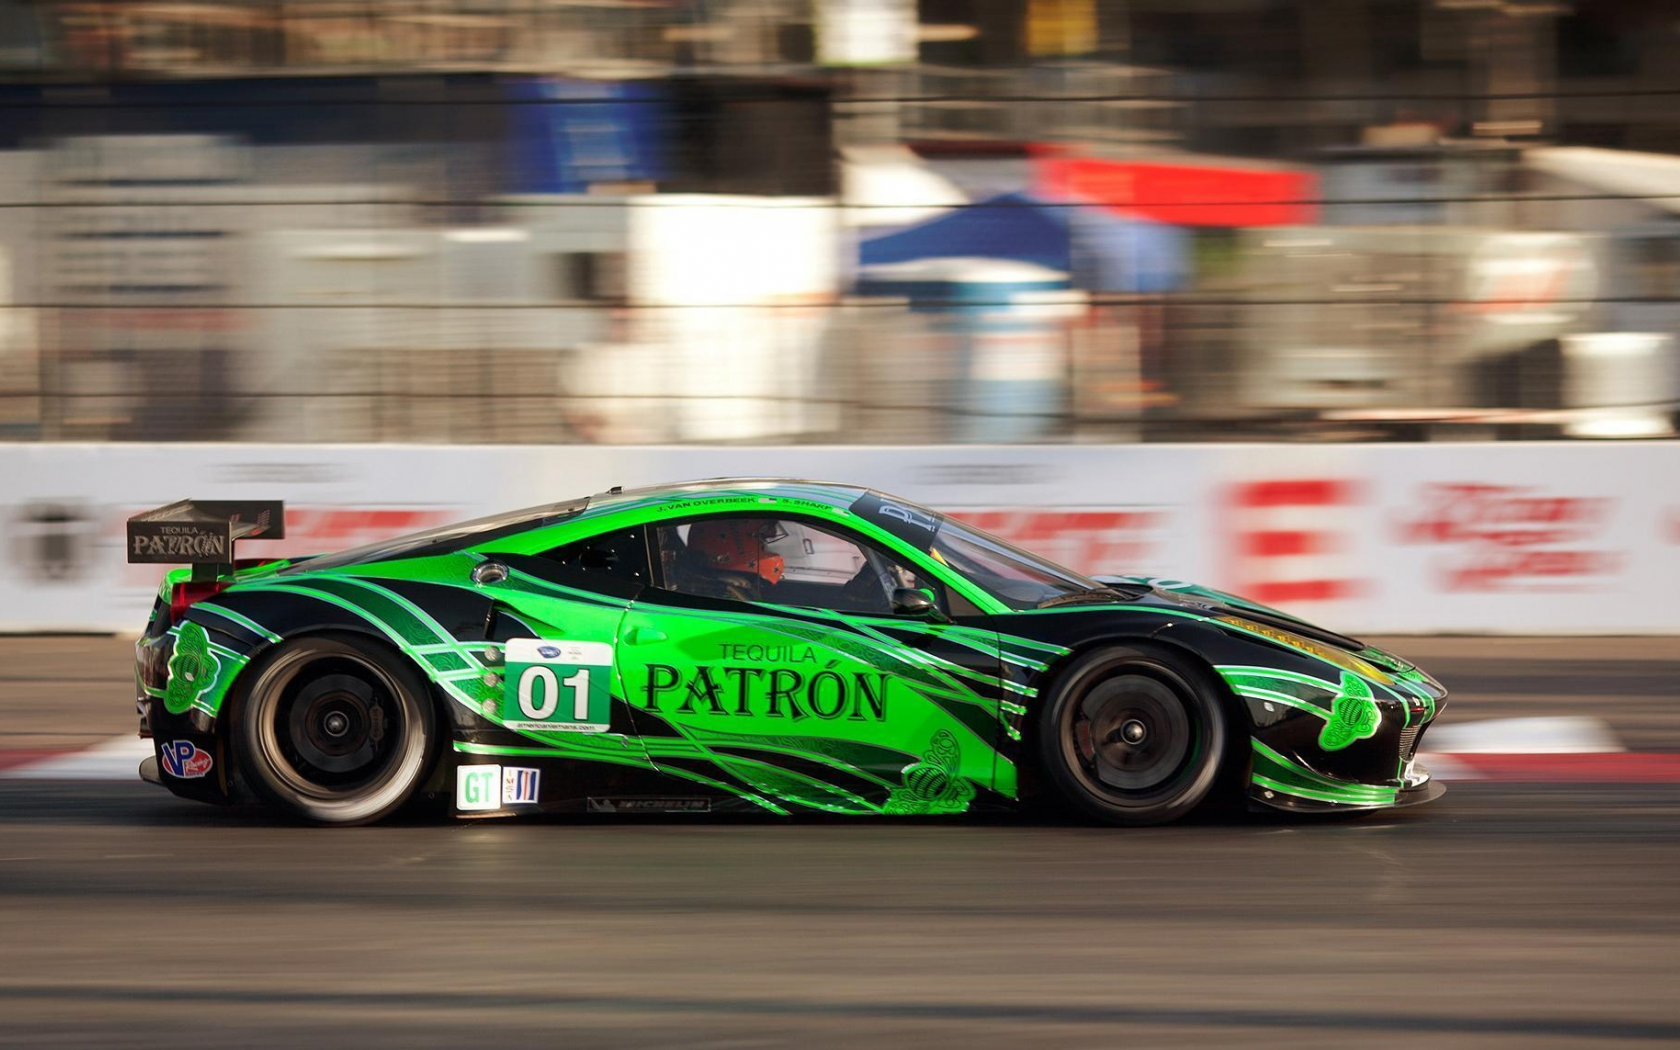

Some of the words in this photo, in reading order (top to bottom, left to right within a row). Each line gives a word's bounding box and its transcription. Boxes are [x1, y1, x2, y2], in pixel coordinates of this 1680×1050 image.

[667, 502, 691, 511] VAN
[694, 496, 755, 507] OVERBEEK
[794, 500, 832, 510] SHARP
[160, 526, 199, 535] TEQUILA
[719, 643, 818, 664] TEQUILA
[517, 664, 590, 721] 01
[640, 659, 894, 723] PATRÓN
[161, 740, 196, 778] VP
[465, 771, 494, 803] GT
